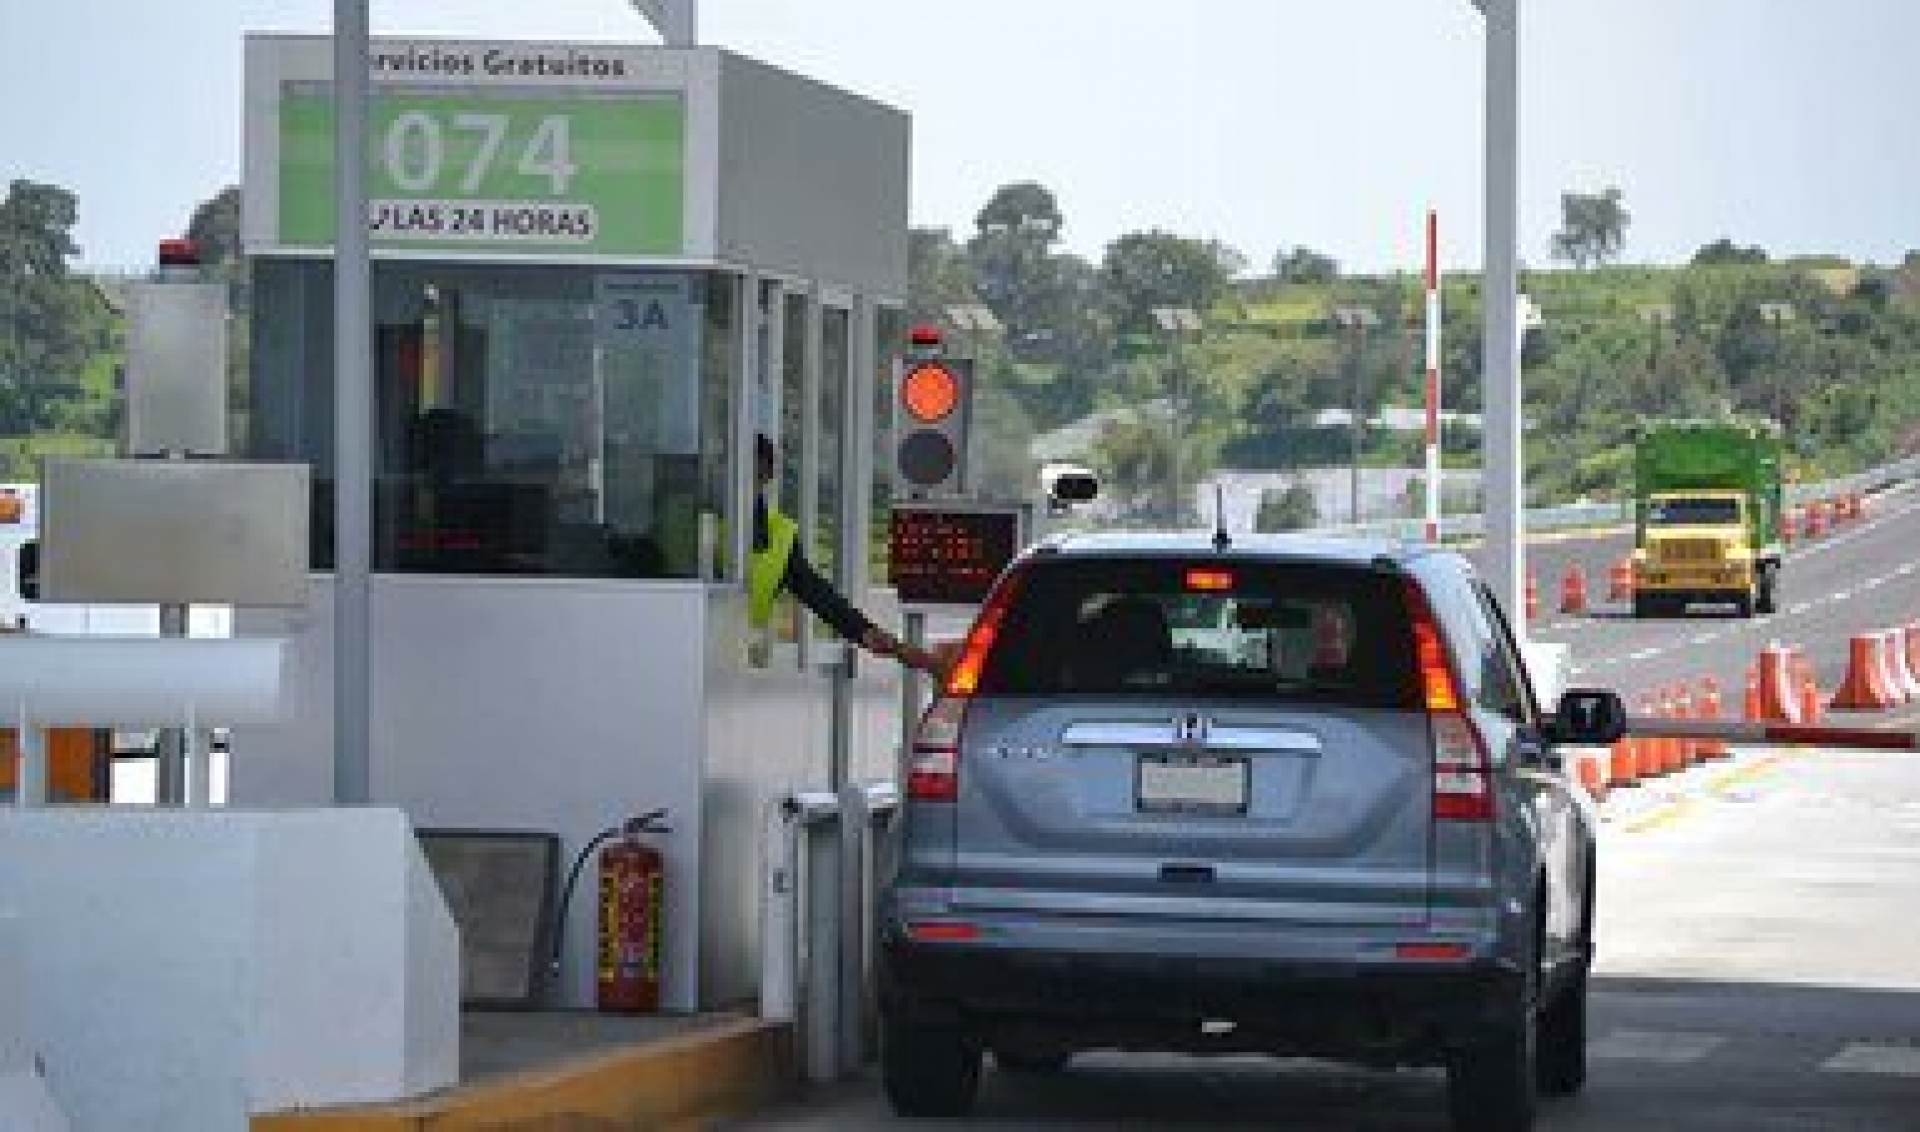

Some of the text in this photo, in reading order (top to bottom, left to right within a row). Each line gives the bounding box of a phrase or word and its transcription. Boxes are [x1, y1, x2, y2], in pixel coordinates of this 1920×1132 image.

[369, 47, 626, 77] rvicios Gratuitos
[384, 110, 579, 195] 074
[450, 206, 485, 234] 24
[493, 208, 592, 237] HORAS
